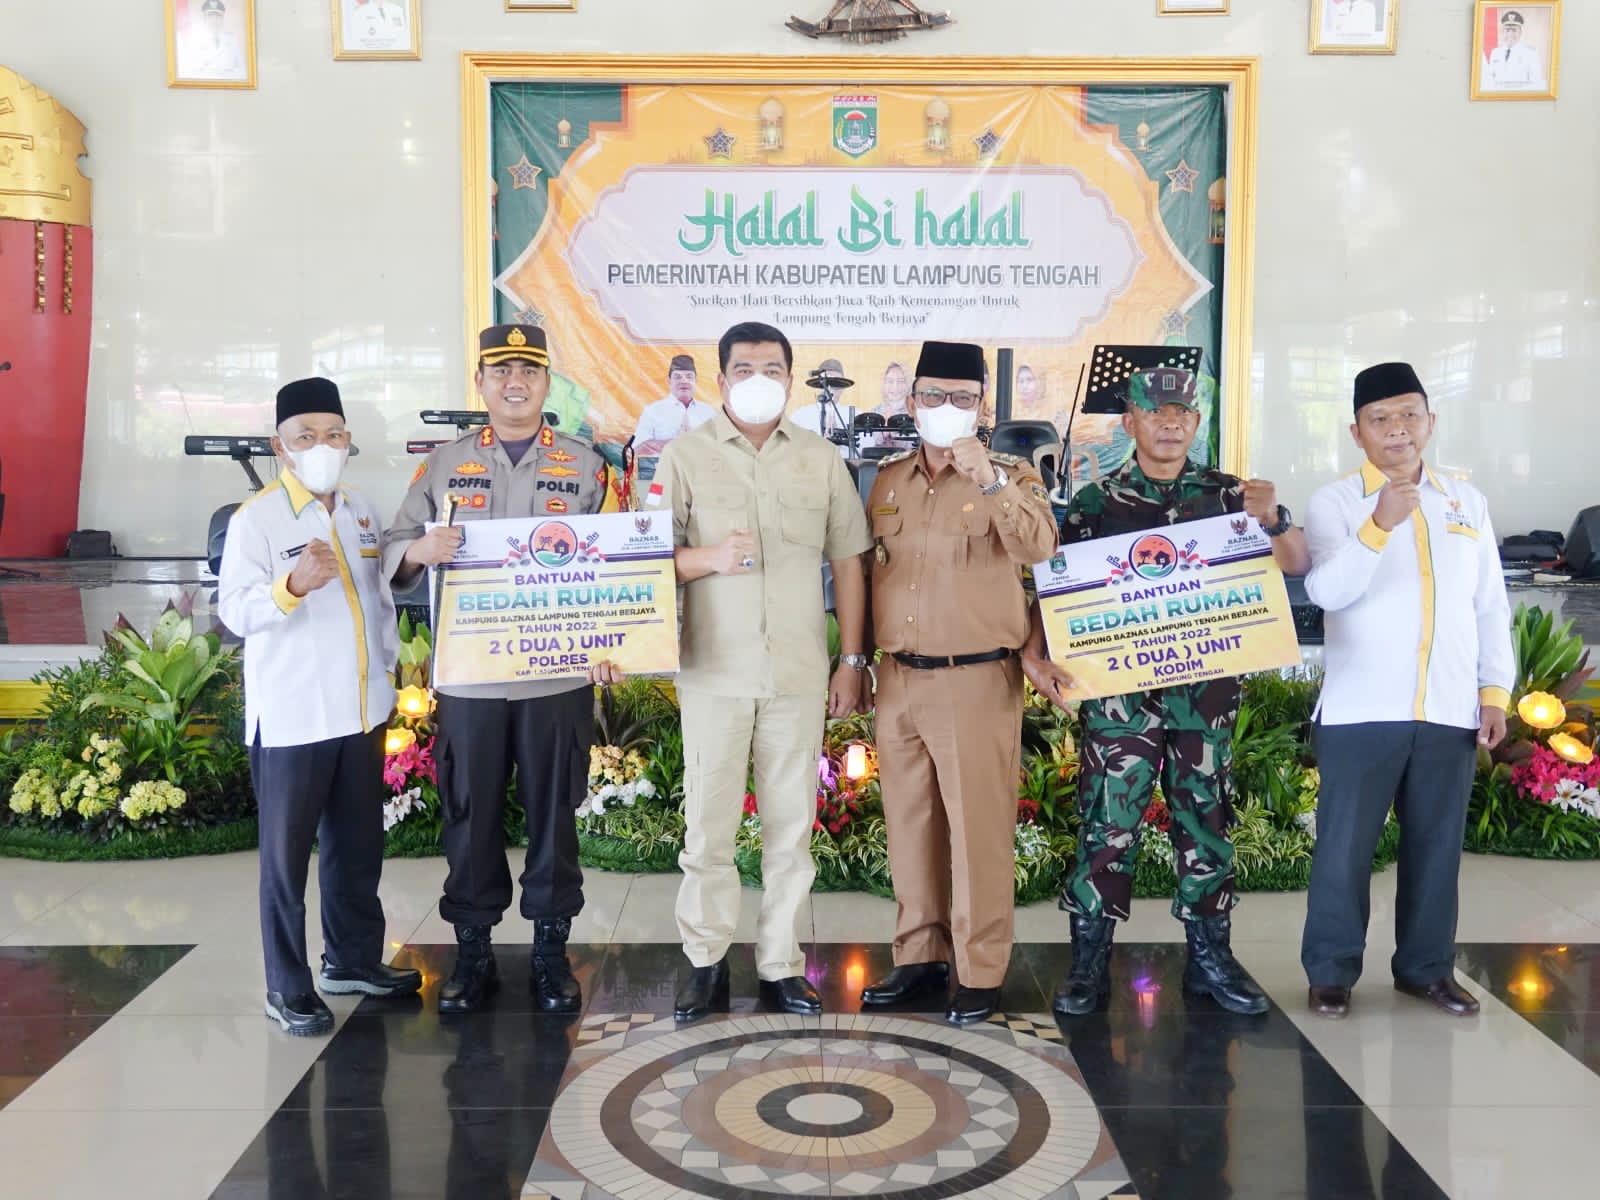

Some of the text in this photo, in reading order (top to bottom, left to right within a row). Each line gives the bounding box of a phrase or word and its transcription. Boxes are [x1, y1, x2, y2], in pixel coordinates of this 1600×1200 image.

[678, 184, 1029, 256] Halal Bi halal
[608, 264, 1099, 285] PEMERINTAH KABUPATEN LAMPUNG TENGAH
[741, 293, 768, 306] Hati
[772, 294, 832, 307] Bersihkan
[834, 294, 863, 307] Jiwa
[865, 294, 895, 307] Raih
[898, 294, 976, 309] Kemenangan
[980, 294, 1020, 308] Untuk
[775, 311, 831, 326] Lampung
[833, 311, 876, 326] Tengah
[448, 477, 491, 489] DOFFIE
[536, 480, 580, 495] POLRI
[514, 571, 595, 585] BANTUAN
[458, 583, 653, 612] BEDAH RUMAH
[1121, 579, 1201, 603] BANTUAN
[456, 607, 656, 625] KAMPUNG BAZNAS LAMPUNG TENGAH BERJAYA
[1069, 583, 1263, 635] BEDAH RUMAH
[517, 622, 597, 634] TAHUN 2022
[1069, 607, 1269, 648] KAMPUNG BAZNAS LAMPUNG TENGAH BERJAYA
[489, 640, 500, 654] 2
[520, 637, 561, 653] DUA
[581, 633, 626, 649] UNIT
[1132, 627, 1212, 648] TAHUN 2022
[529, 653, 588, 667] POLRES
[1107, 657, 1119, 671] 2
[1136, 647, 1179, 666] DUA
[1196, 635, 1242, 655] UNIT
[1153, 658, 1204, 677] KODIM
[1156, 674, 1192, 685] LAMPUNG
[1194, 668, 1224, 679] TENGAH
